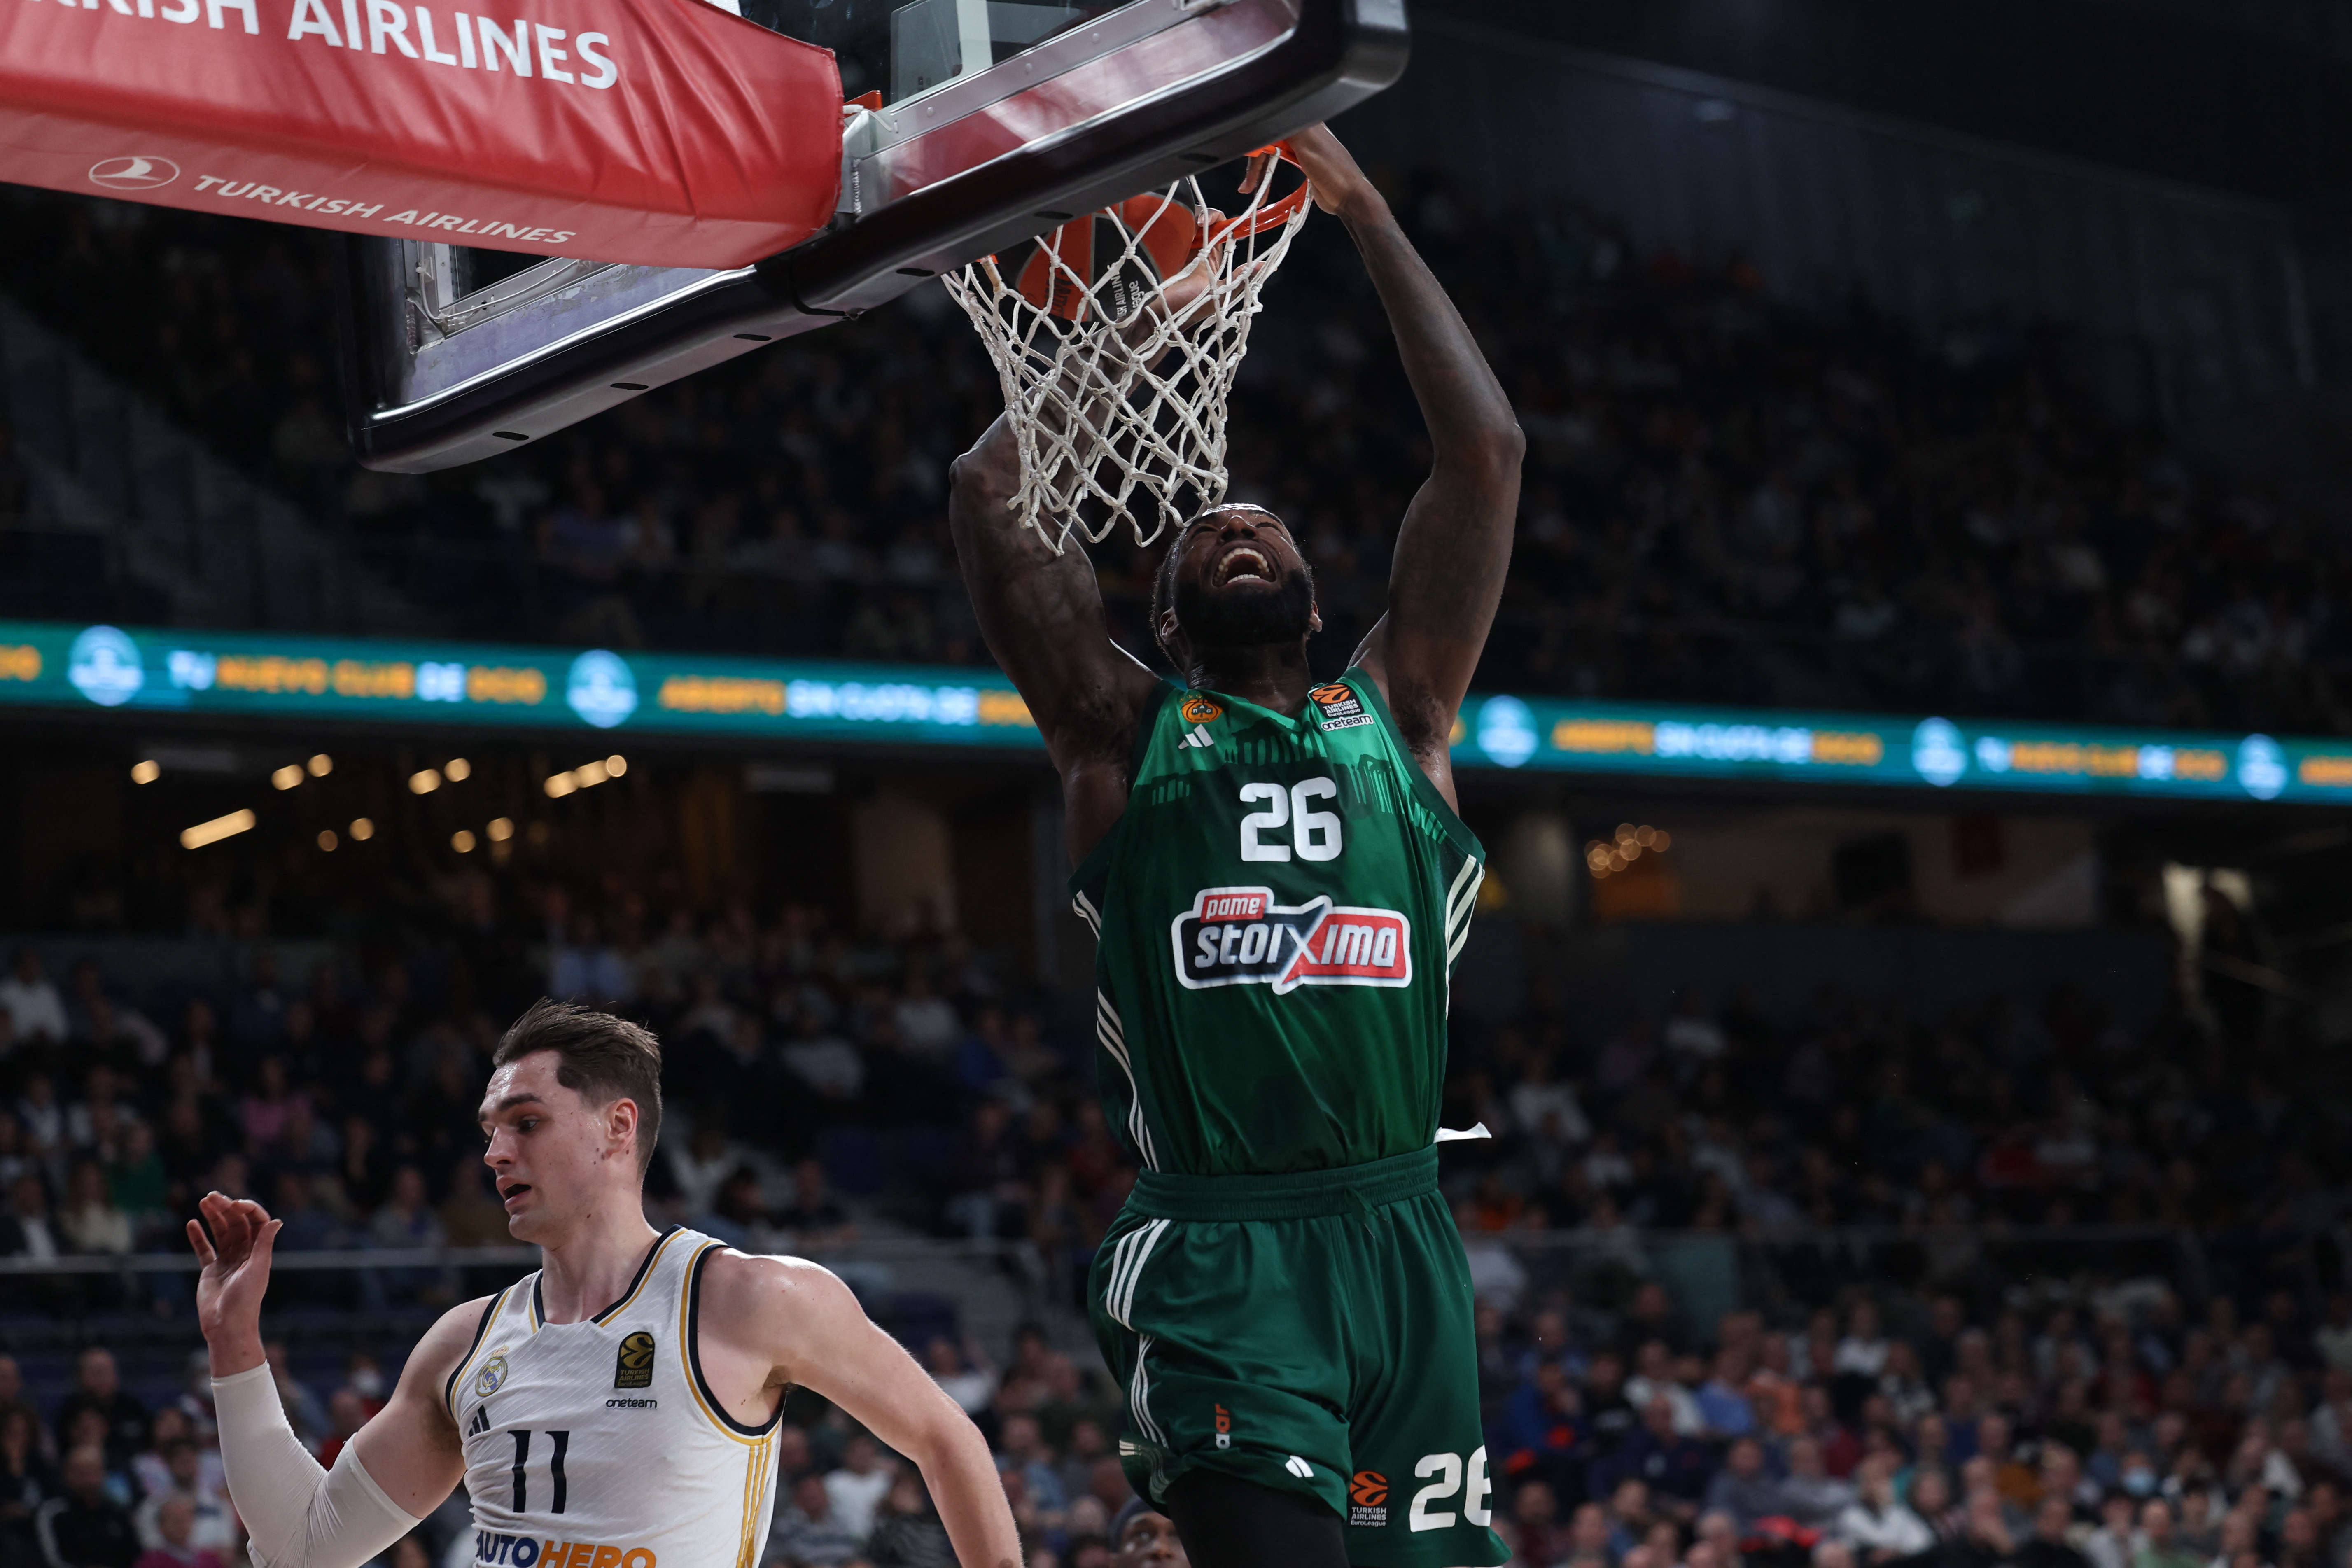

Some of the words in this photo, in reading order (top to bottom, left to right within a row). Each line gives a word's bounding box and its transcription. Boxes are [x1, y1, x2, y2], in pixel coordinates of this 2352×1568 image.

[287, 0, 618, 89] AIRLINES
[193, 175, 384, 219] TURKISH
[383, 210, 576, 244] AIRLINES
[1129, 281, 1145, 312] eague
[1323, 699, 1356, 709] TURKISH
[1326, 703, 1358, 714] AIRLINES
[1327, 709, 1360, 717] EuroLeague
[1322, 715, 1372, 730] oneteam
[1239, 777, 1342, 862] 26
[1206, 897, 1260, 919] pame
[606, 1398, 658, 1409] oneteam
[507, 1430, 569, 1514] 11
